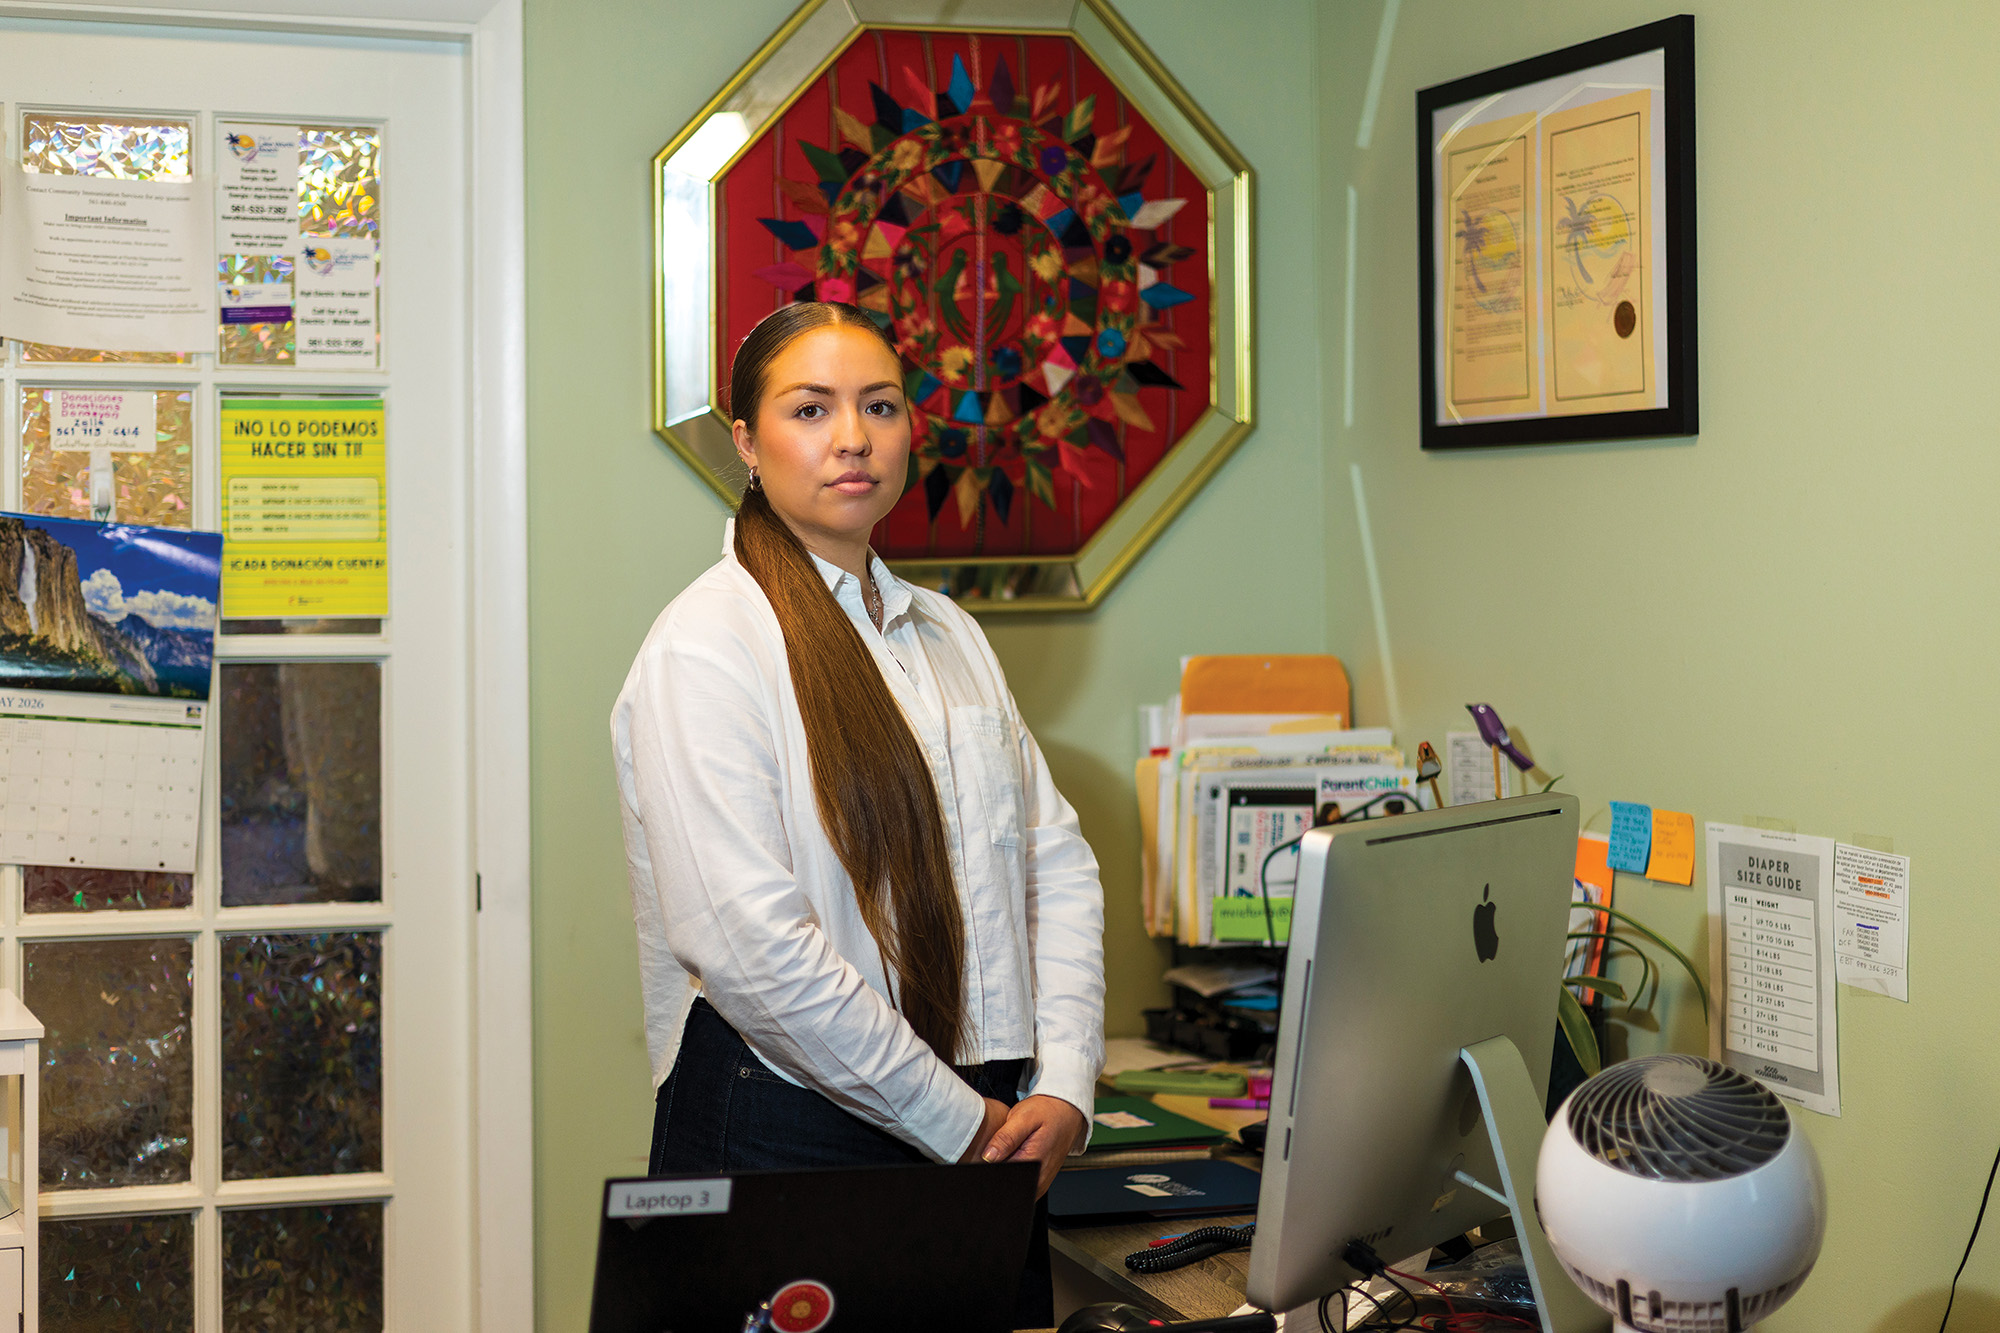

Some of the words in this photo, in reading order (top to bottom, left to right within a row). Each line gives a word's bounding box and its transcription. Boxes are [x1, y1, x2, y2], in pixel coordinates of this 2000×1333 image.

[64, 213, 103, 224] Important
[104, 216, 148, 225] Information
[61, 390, 124, 403] Donaciones
[61, 401, 121, 411] Donations
[270, 420, 292, 437] LO
[298, 420, 378, 437] PODEMOS
[251, 442, 306, 458] HACER
[312, 442, 337, 458] SIN
[271, 556, 334, 571] DONACIÓN
[18, 698, 44, 710] 2026
[1748, 856, 1790, 874] DIAPER
[1737, 870, 1762, 885] SIZE
[1766, 875, 1802, 892] GUIDE
[1734, 895, 1748, 904] SIZE
[1756, 899, 1779, 910] WEIGHT
[1765, 920, 1774, 928] TO
[1780, 923, 1792, 931] LBS
[1766, 935, 1774, 943] TO
[1784, 939, 1795, 948] LBS
[1770, 952, 1781, 960] LBS
[1772, 967, 1783, 977] LBS
[1773, 983, 1784, 992] LBS
[1774, 998, 1785, 1008] LBS
[1767, 1013, 1778, 1022] LBS
[1768, 1028, 1779, 1038] LBS
[1767, 1044, 1778, 1054] LBS
[626, 1192, 693, 1212] Laptop
[698, 1190, 710, 1208] 3
